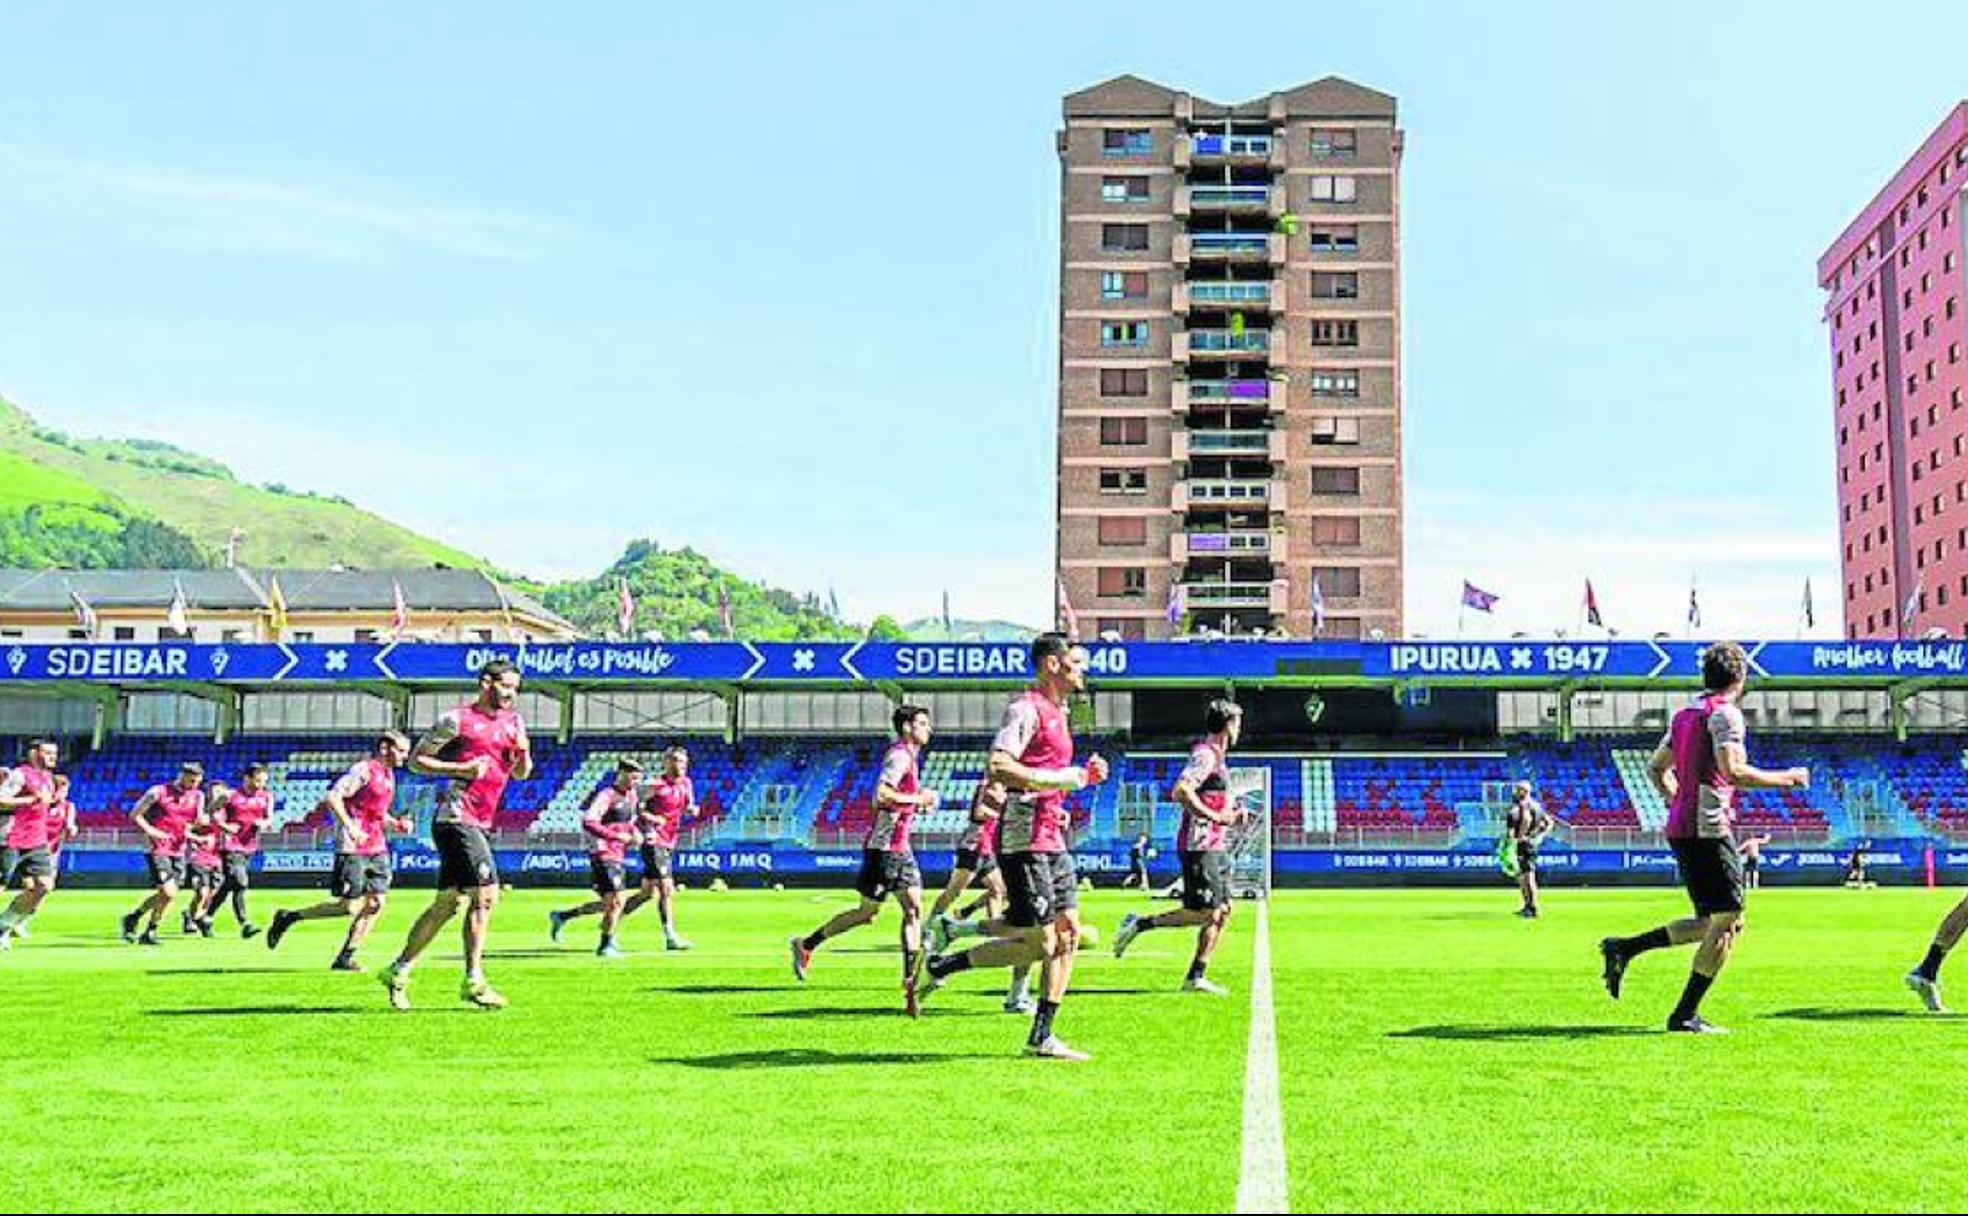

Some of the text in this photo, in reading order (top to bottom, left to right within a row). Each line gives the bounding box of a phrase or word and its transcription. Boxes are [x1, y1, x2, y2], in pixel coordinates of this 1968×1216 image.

[578, 650, 600, 669] es
[1391, 645, 1609, 671] IPURUA 1947
[679, 853, 772, 870] IMQ IMQ
